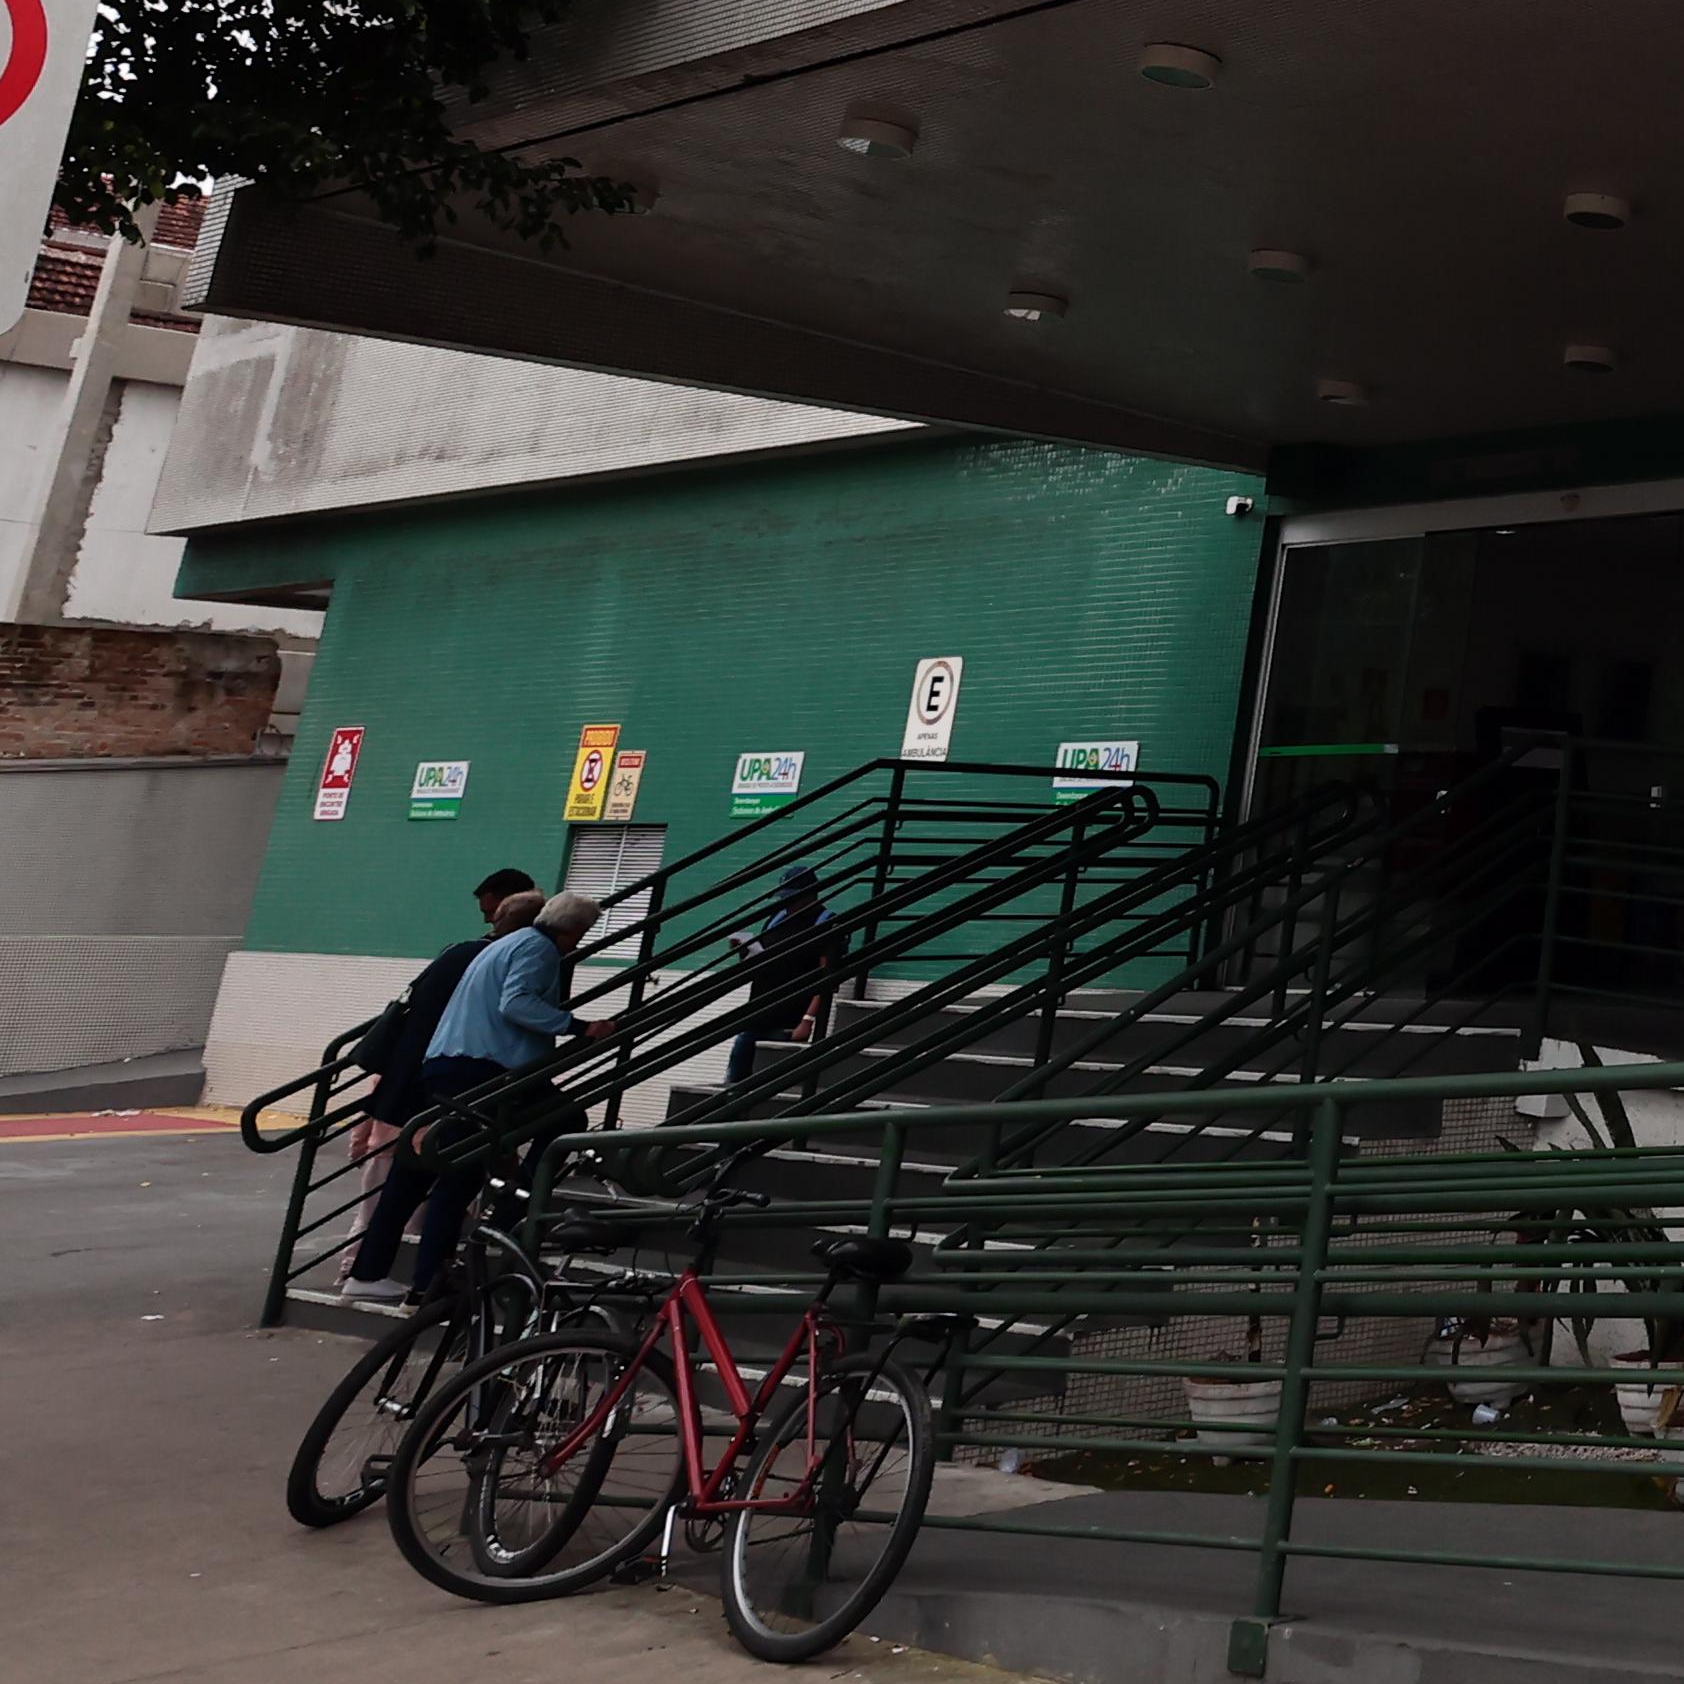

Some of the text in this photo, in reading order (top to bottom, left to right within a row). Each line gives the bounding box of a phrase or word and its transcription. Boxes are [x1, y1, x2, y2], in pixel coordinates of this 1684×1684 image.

[926, 676, 945, 712] E
[917, 732, 939, 741] APENAS
[902, 745, 947, 758] AMBULÂNCIA
[1062, 746, 1131, 772] UPA 24h
[740, 756, 797, 781] UPA 24h
